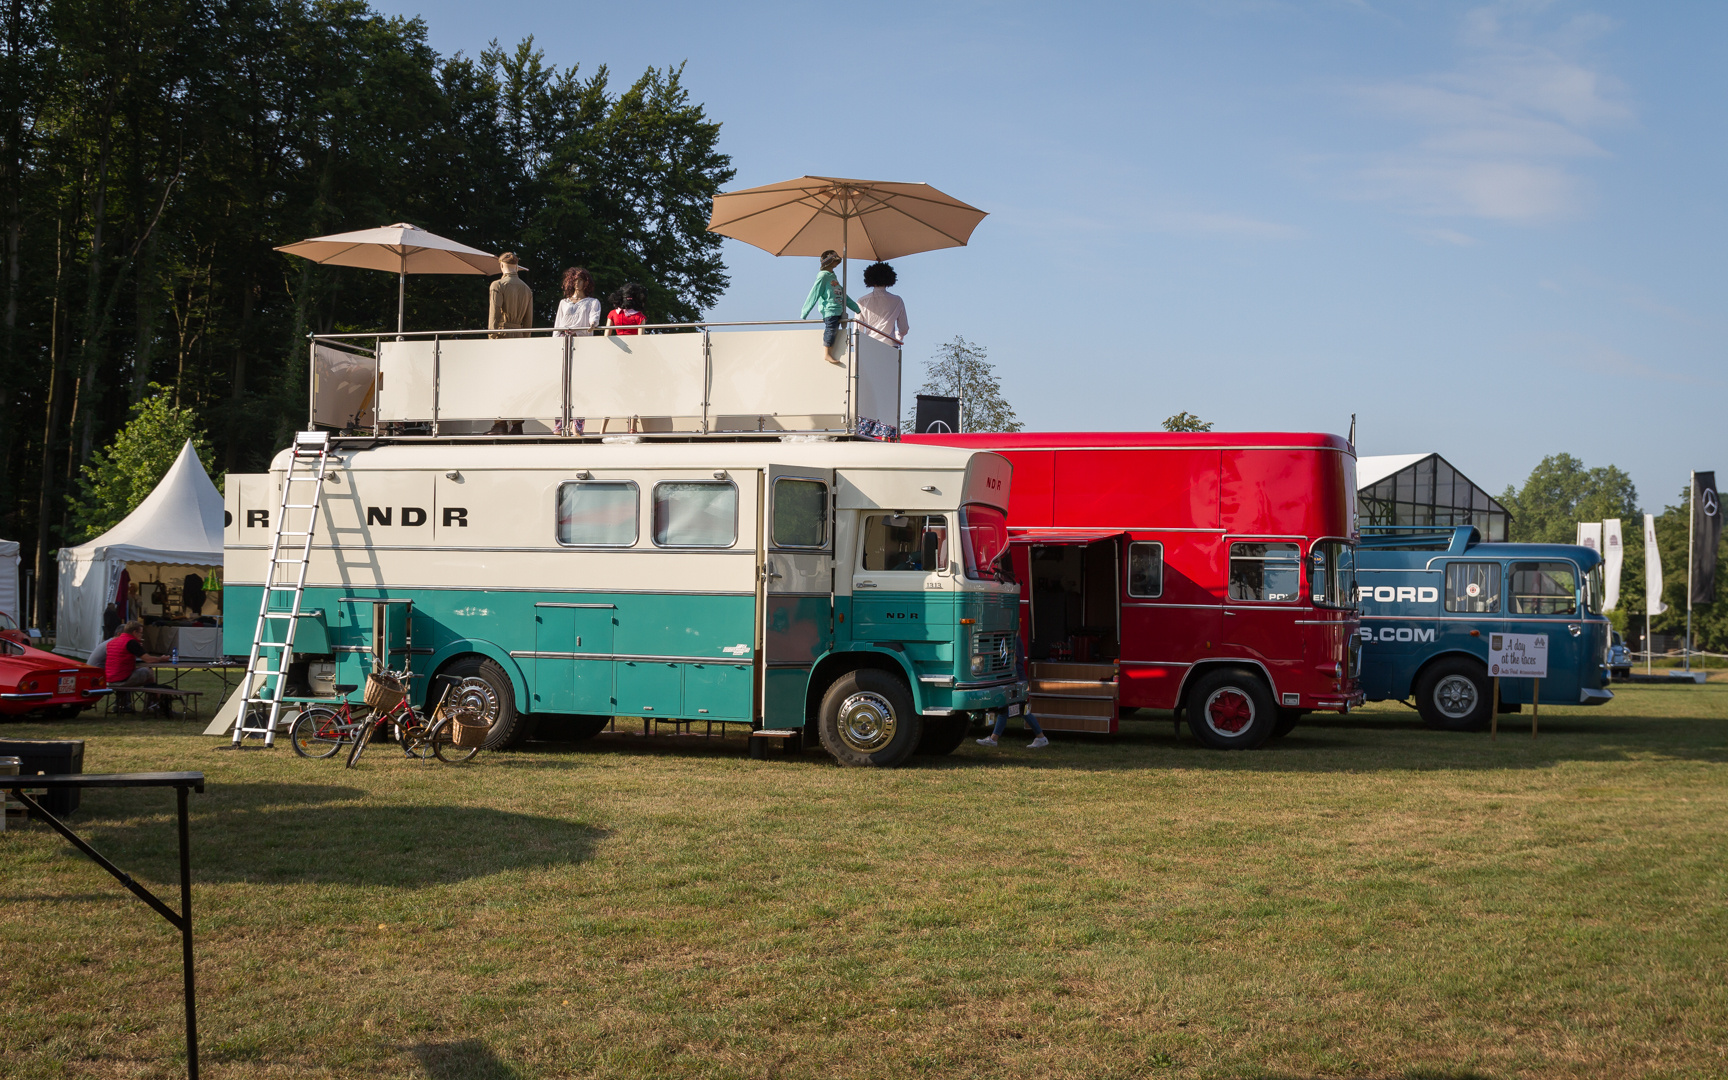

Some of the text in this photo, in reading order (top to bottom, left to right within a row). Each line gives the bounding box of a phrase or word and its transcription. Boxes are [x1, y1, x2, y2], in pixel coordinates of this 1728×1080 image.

[985, 476, 1002, 491] NDR
[367, 506, 469, 527] NDR
[1357, 586, 1438, 603] FORD
[1505, 638, 1526, 656] A day
[1501, 651, 1536, 665] at the races
